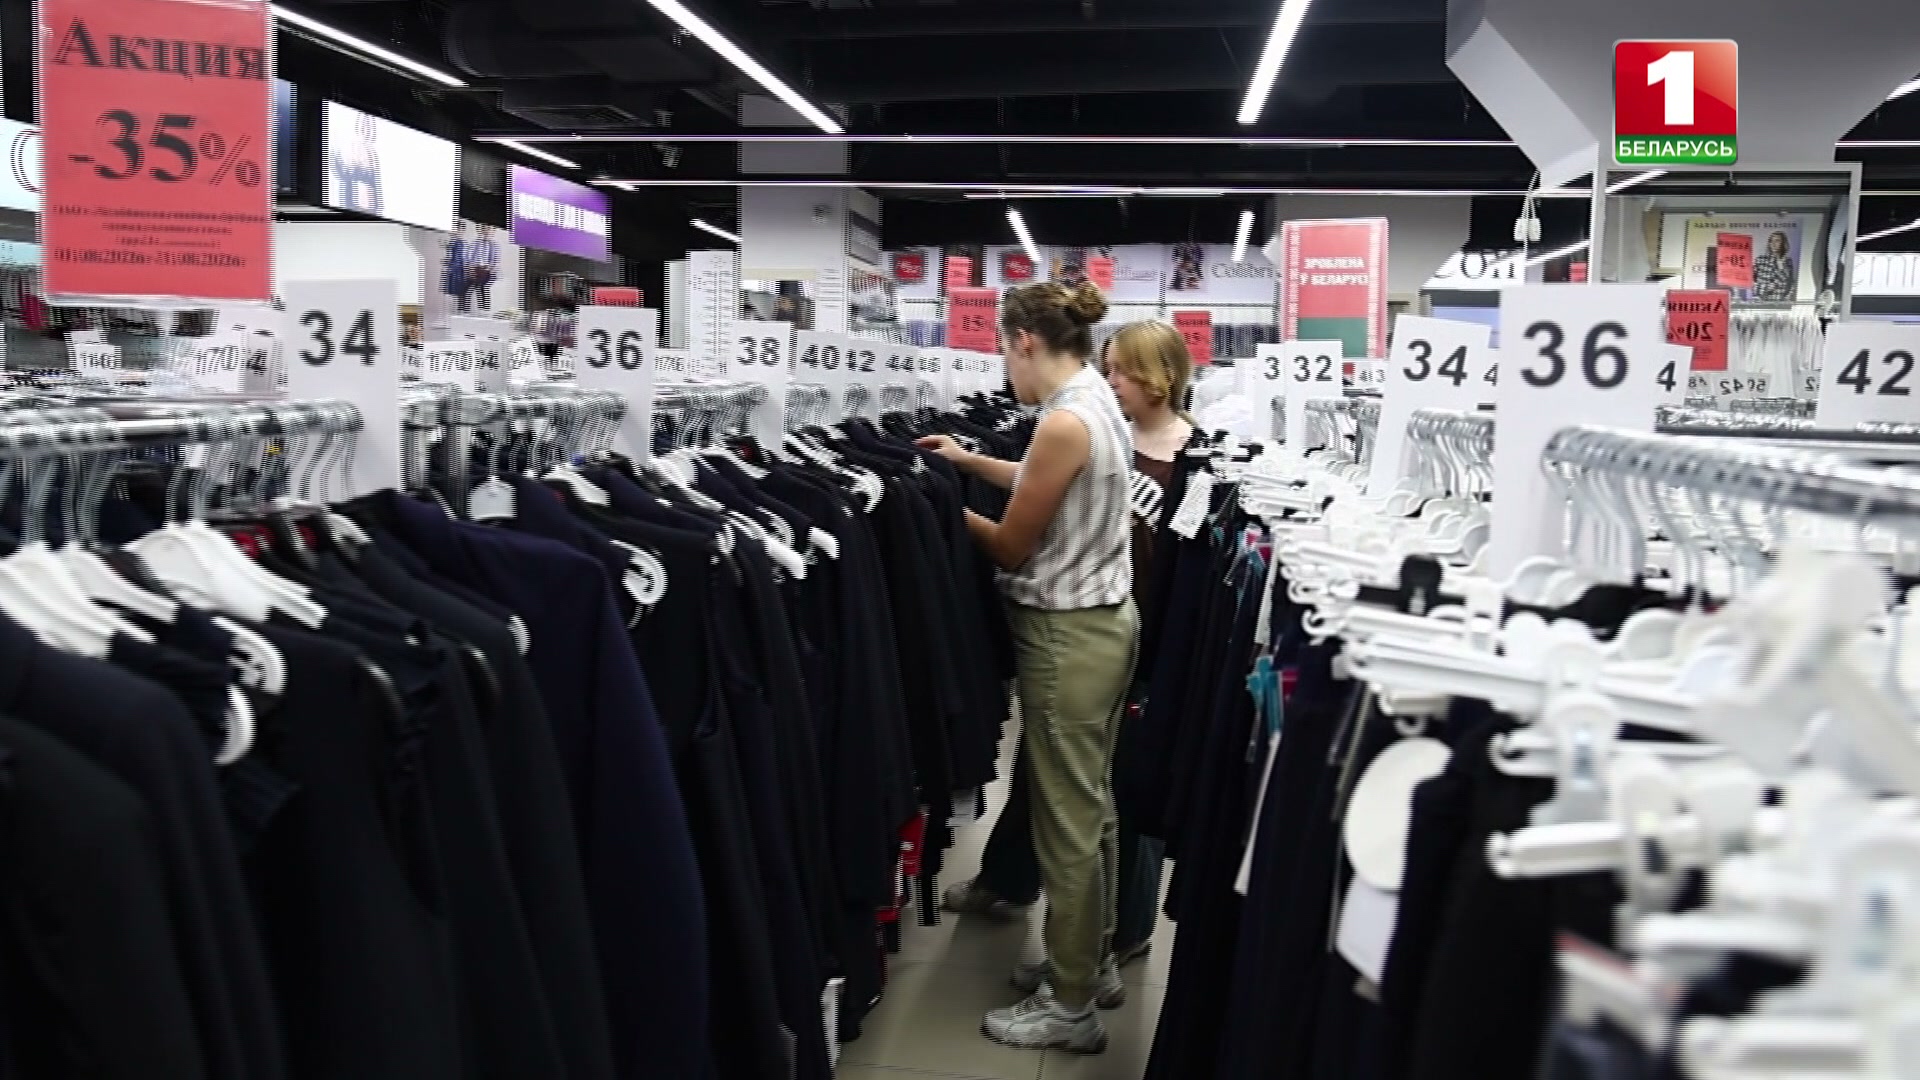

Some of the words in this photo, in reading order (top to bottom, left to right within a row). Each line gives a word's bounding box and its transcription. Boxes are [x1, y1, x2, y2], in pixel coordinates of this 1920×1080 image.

[52, 16, 268, 81] Акция
[68, 108, 262, 188] -35%
[1211, 260, 1273, 279] Colibri
[1304, 257, 1365, 270] ЗРОБЛЕНА
[299, 310, 380, 367] 34
[586, 329, 643, 370] 36
[737, 336, 780, 366] 38
[1521, 321, 1629, 388] 36
[426, 351, 471, 373] 170
[800, 345, 840, 370] 40
[885, 354, 914, 372] 44
[1294, 355, 1332, 381] 32
[1403, 339, 1468, 387] 34
[1838, 348, 1914, 395] 42
